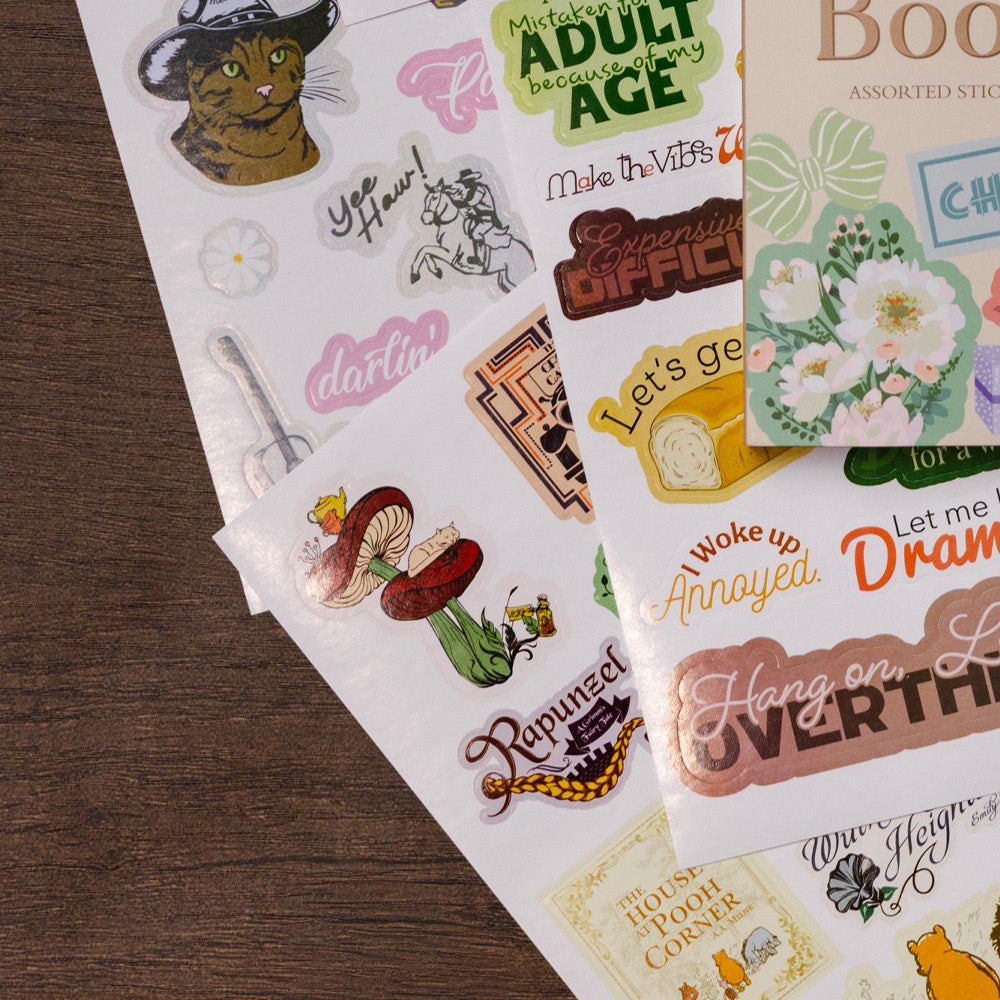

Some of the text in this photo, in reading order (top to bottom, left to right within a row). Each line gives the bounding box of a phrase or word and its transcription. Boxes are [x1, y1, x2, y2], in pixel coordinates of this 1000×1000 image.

[509, 1, 612, 37] Mistaken
[527, 40, 705, 95] because of my
[570, 57, 687, 130] AGE
[849, 84, 952, 101] ASSORTED
[357, 145, 428, 244] Haw!
[545, 164, 614, 201] Make
[616, 153, 654, 182] the
[648, 139, 713, 173] Vibes
[584, 212, 743, 278] Expensive
[601, 357, 687, 435] Let's
[680, 521, 801, 577] I Woke up
[893, 509, 938, 538] Let
[945, 500, 988, 526] me
[649, 548, 822, 626] Annoyed.
[465, 643, 627, 817] Rapunzel
[690, 662, 836, 741] Hang
[844, 658, 905, 689] on,
[617, 885, 646, 911] THE
[625, 866, 704, 928] HOUSE
[648, 877, 723, 938] POOH
[644, 891, 742, 970] CORNER
